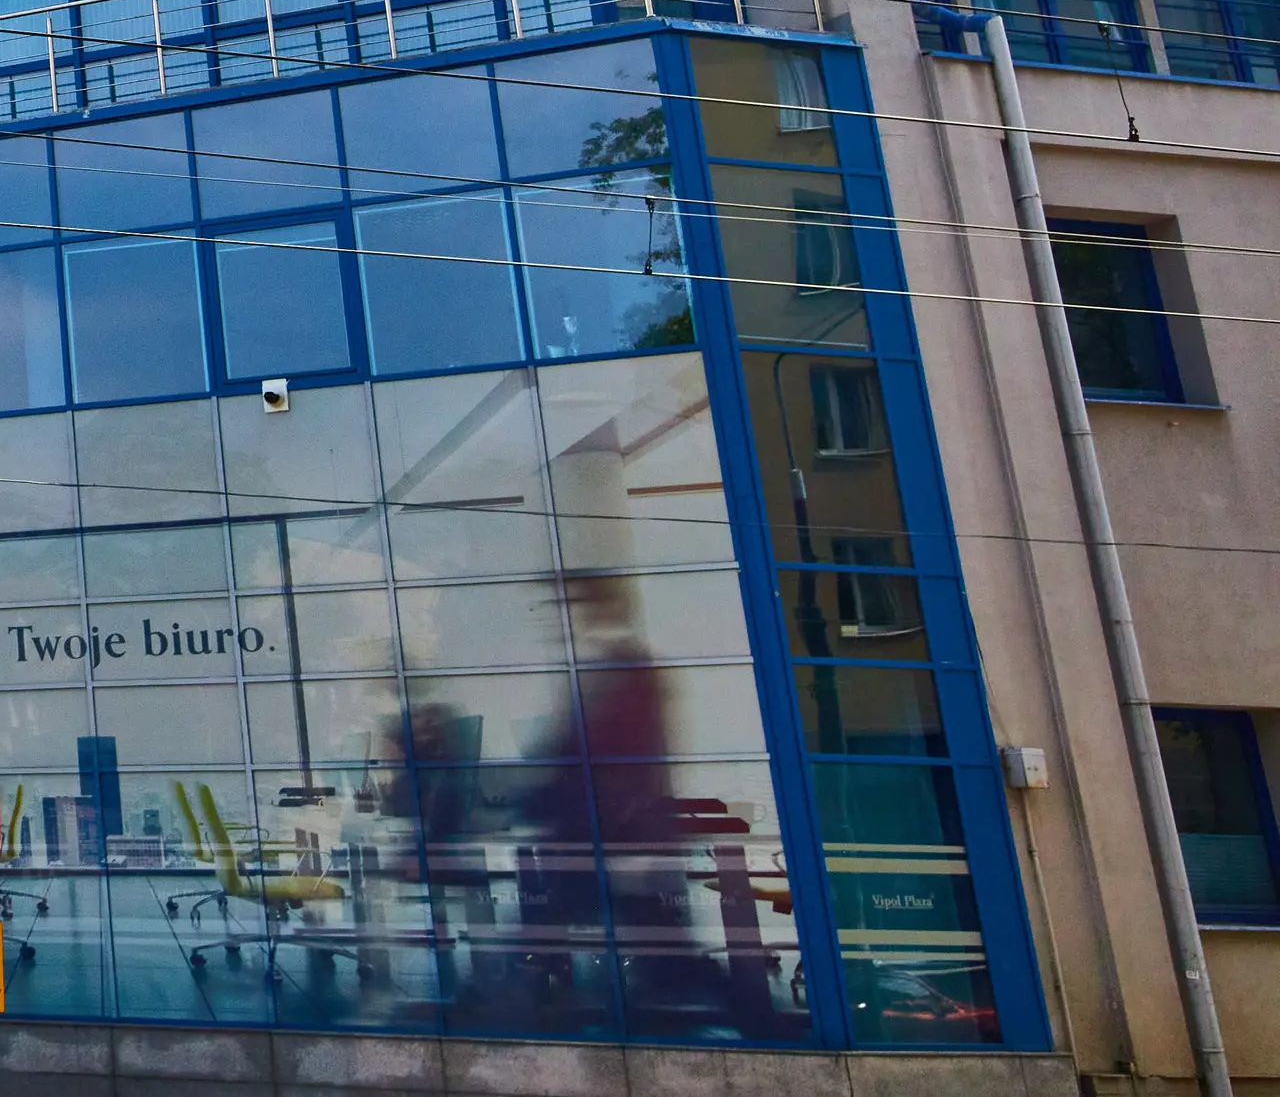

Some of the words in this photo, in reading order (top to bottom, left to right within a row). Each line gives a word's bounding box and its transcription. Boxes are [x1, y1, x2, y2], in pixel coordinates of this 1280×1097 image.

[8, 625, 126, 669] Twoje
[144, 618, 277, 657] biuro.
[872, 894, 901, 910] Vipol
[904, 894, 933, 907] Plaza
